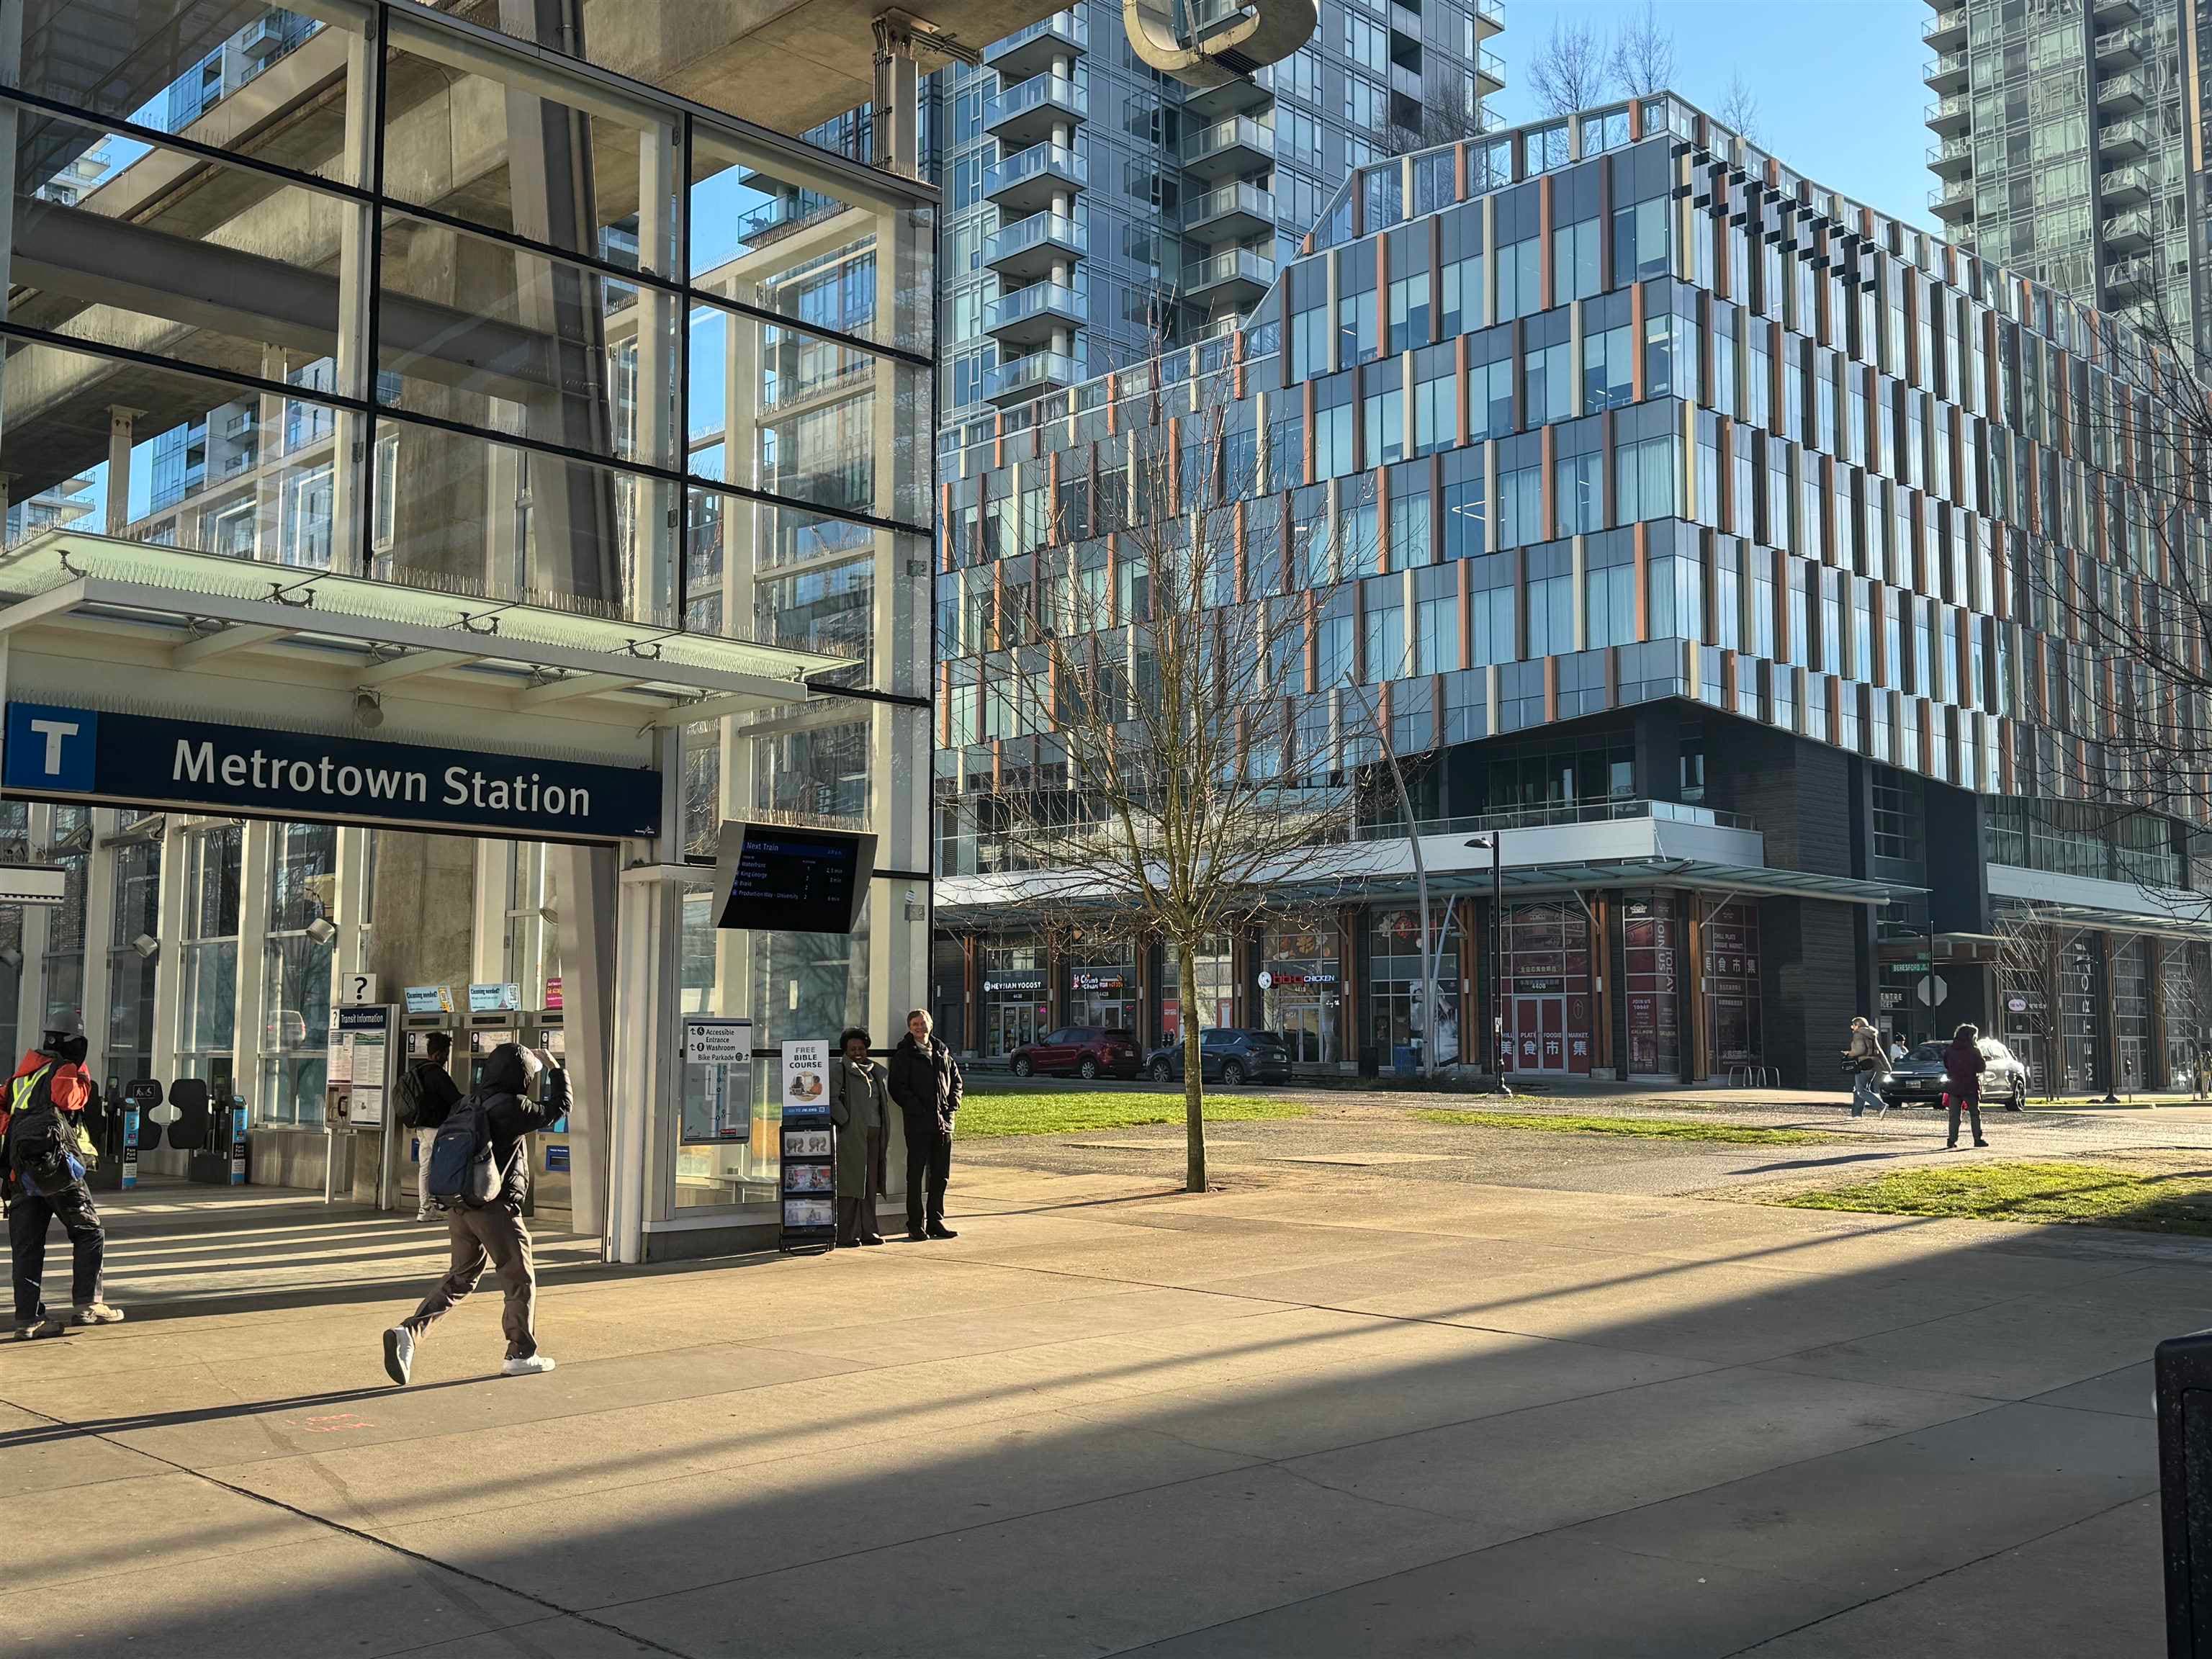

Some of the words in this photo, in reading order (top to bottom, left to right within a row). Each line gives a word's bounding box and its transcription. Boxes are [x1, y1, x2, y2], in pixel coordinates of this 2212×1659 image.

[31, 719, 78, 775] T
[172, 739, 427, 803] Metrotown
[442, 766, 590, 817] Station
[747, 842, 762, 851] Next
[763, 842, 779, 852] Train
[1658, 953, 1665, 971] US
[1894, 963, 1921, 972] BERESFORD
[341, 1014, 356, 1023] Transit
[357, 1013, 384, 1023] Information
